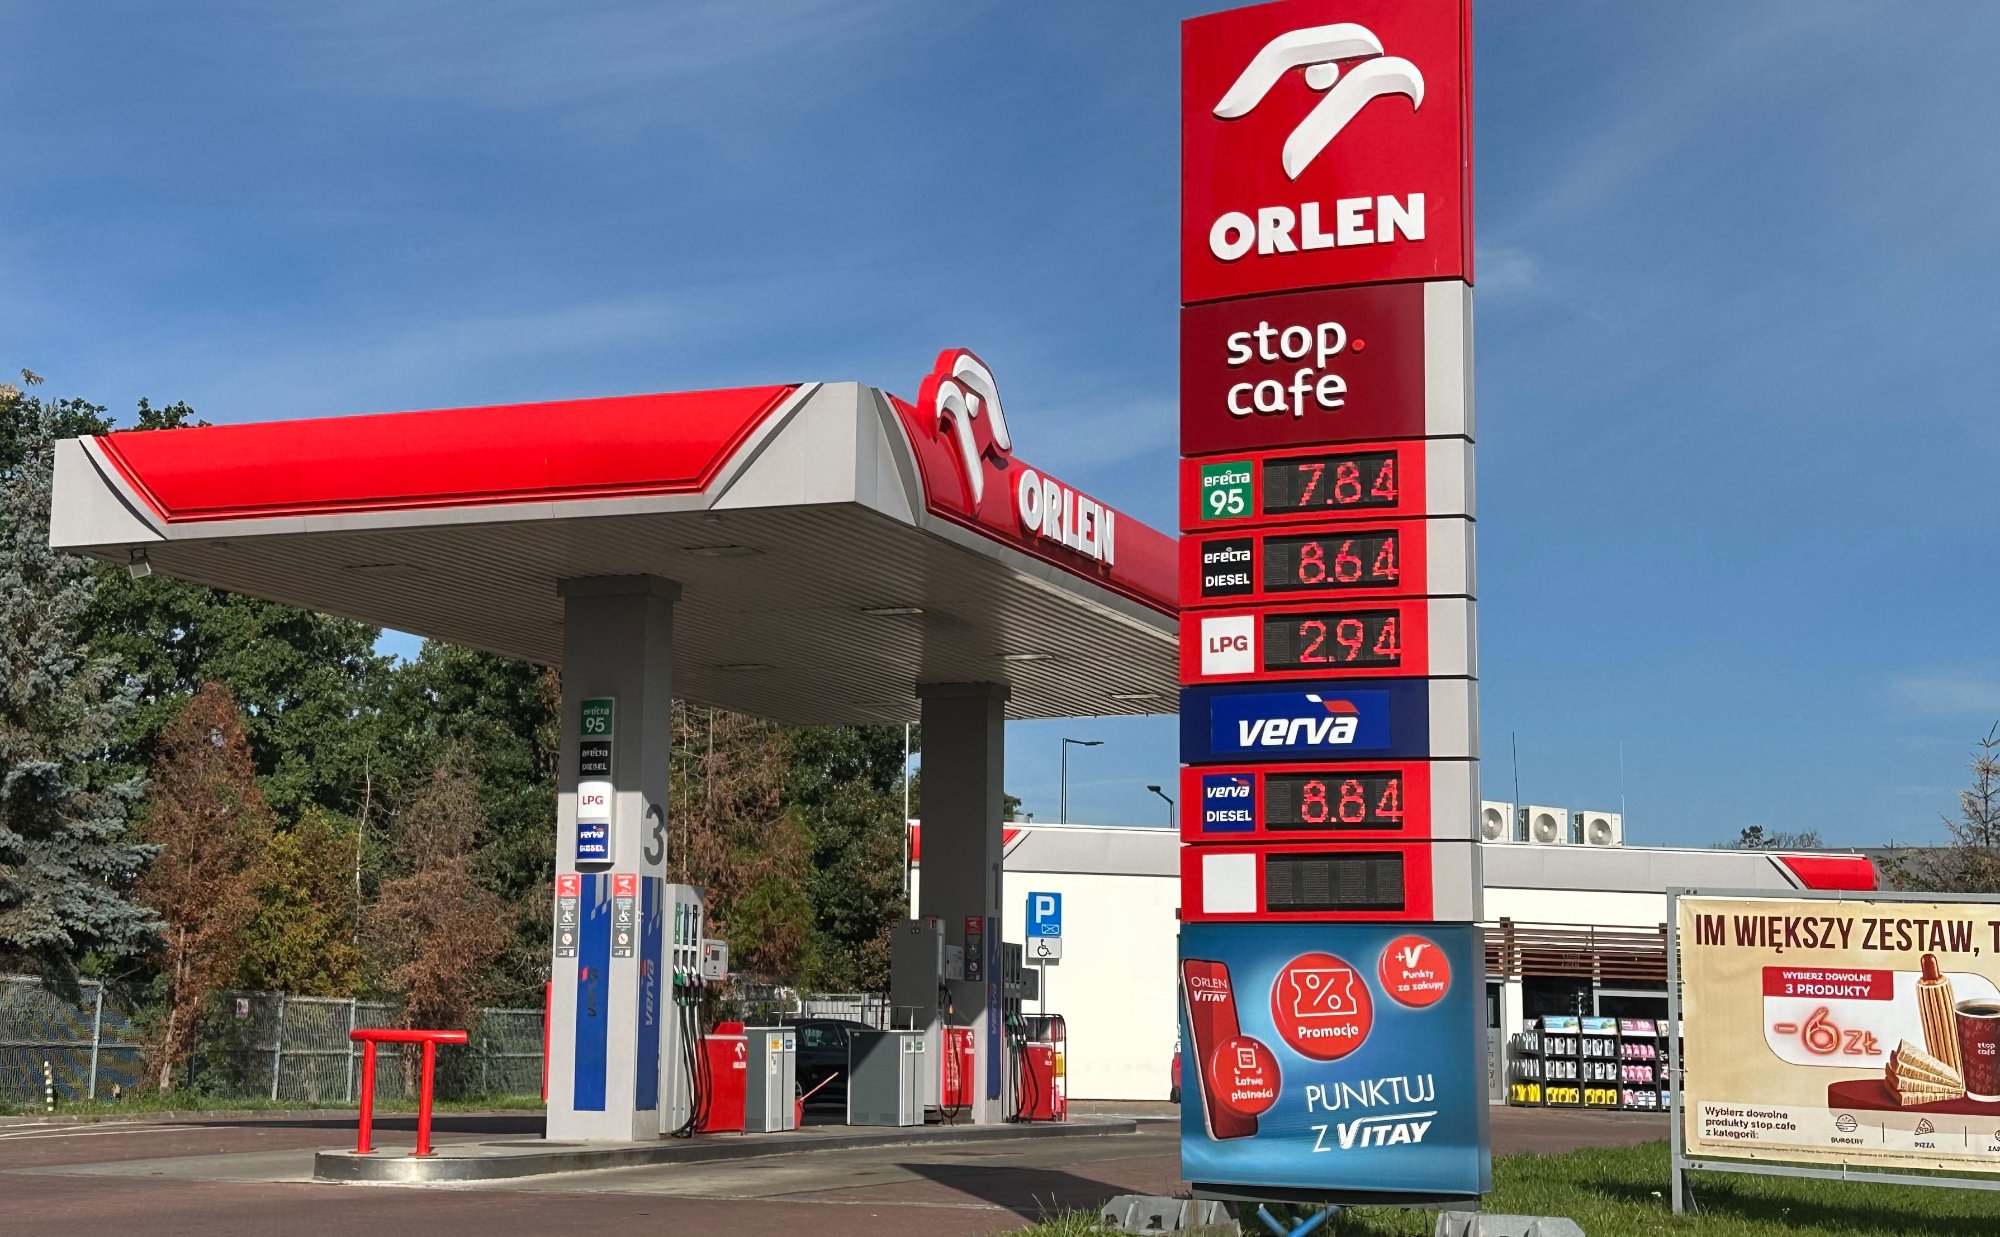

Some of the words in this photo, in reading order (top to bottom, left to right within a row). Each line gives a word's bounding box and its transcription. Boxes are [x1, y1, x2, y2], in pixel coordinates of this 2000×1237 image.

[1209, 193, 1425, 260] ORLEN
[1227, 368, 1347, 416] cafe
[1298, 459, 1397, 506] 7.84
[1209, 488, 1244, 515] 95
[1018, 469, 1114, 565] ORLEN
[1299, 537, 1399, 584] 8.64
[1205, 573, 1250, 587] DIESEL
[1209, 635, 1248, 654] LPG
[1299, 617, 1401, 662] 2.94
[586, 717, 605, 732] 95
[1239, 716, 1359, 747] verva
[583, 795, 604, 805] LPG
[1206, 784, 1250, 799] verva
[1301, 778, 1403, 823] 8.84
[1206, 810, 1252, 823] DIESEL
[643, 804, 664, 866] 3
[1035, 895, 1055, 924] P
[1696, 914, 1726, 946] IM
[1733, 915, 1853, 954] WIĘKSZY
[1862, 918, 1980, 958] ZESTAW,
[1191, 976, 1228, 989] ORLEN
[1402, 969, 1435, 980] Punkty
[1782, 971, 1823, 981] WYBIERZ
[1825, 973, 1872, 982] DOWOLNE
[1785, 984, 1794, 994] 3
[1797, 984, 1871, 997] PRODUKTY
[1298, 1022, 1359, 1039] Promocje
[1305, 1074, 1435, 1113] PUNKTUJ
[1705, 1106, 1744, 1118] Wybierz
[1746, 1109, 1788, 1120] dowolne
[1705, 1118, 1748, 1129] produkty
[1337, 1111, 1438, 1150] VITAY
